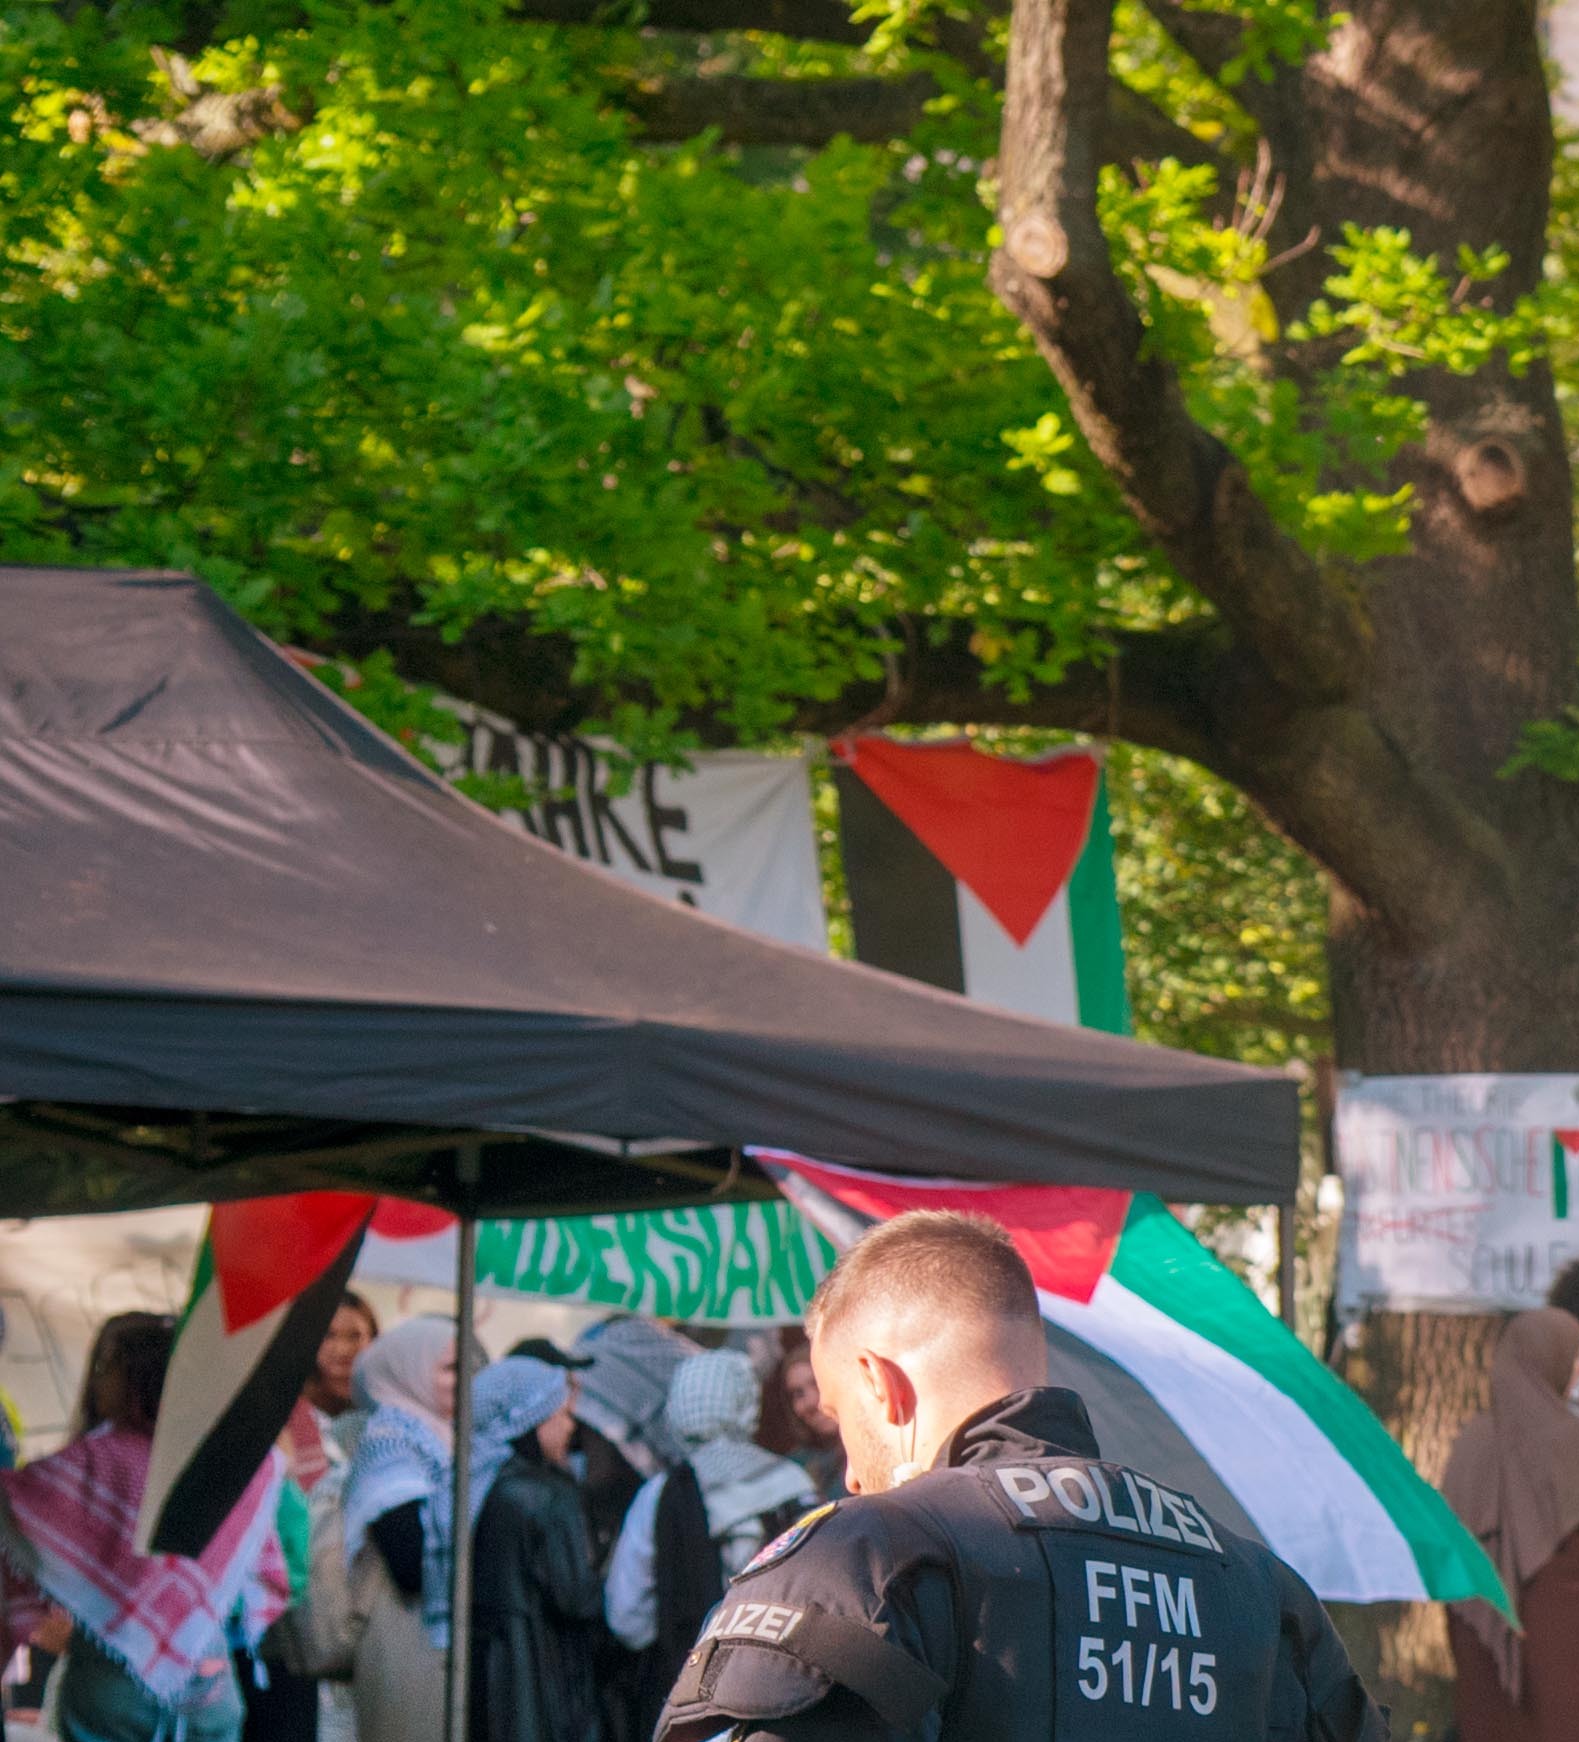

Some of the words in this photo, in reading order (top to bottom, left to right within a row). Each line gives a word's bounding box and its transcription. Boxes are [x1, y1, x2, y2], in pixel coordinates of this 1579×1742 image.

[995, 1466, 1224, 1554] POLIZEI
[1085, 1560, 1202, 1638] FFM
[1078, 1636, 1218, 1716] 51/15
